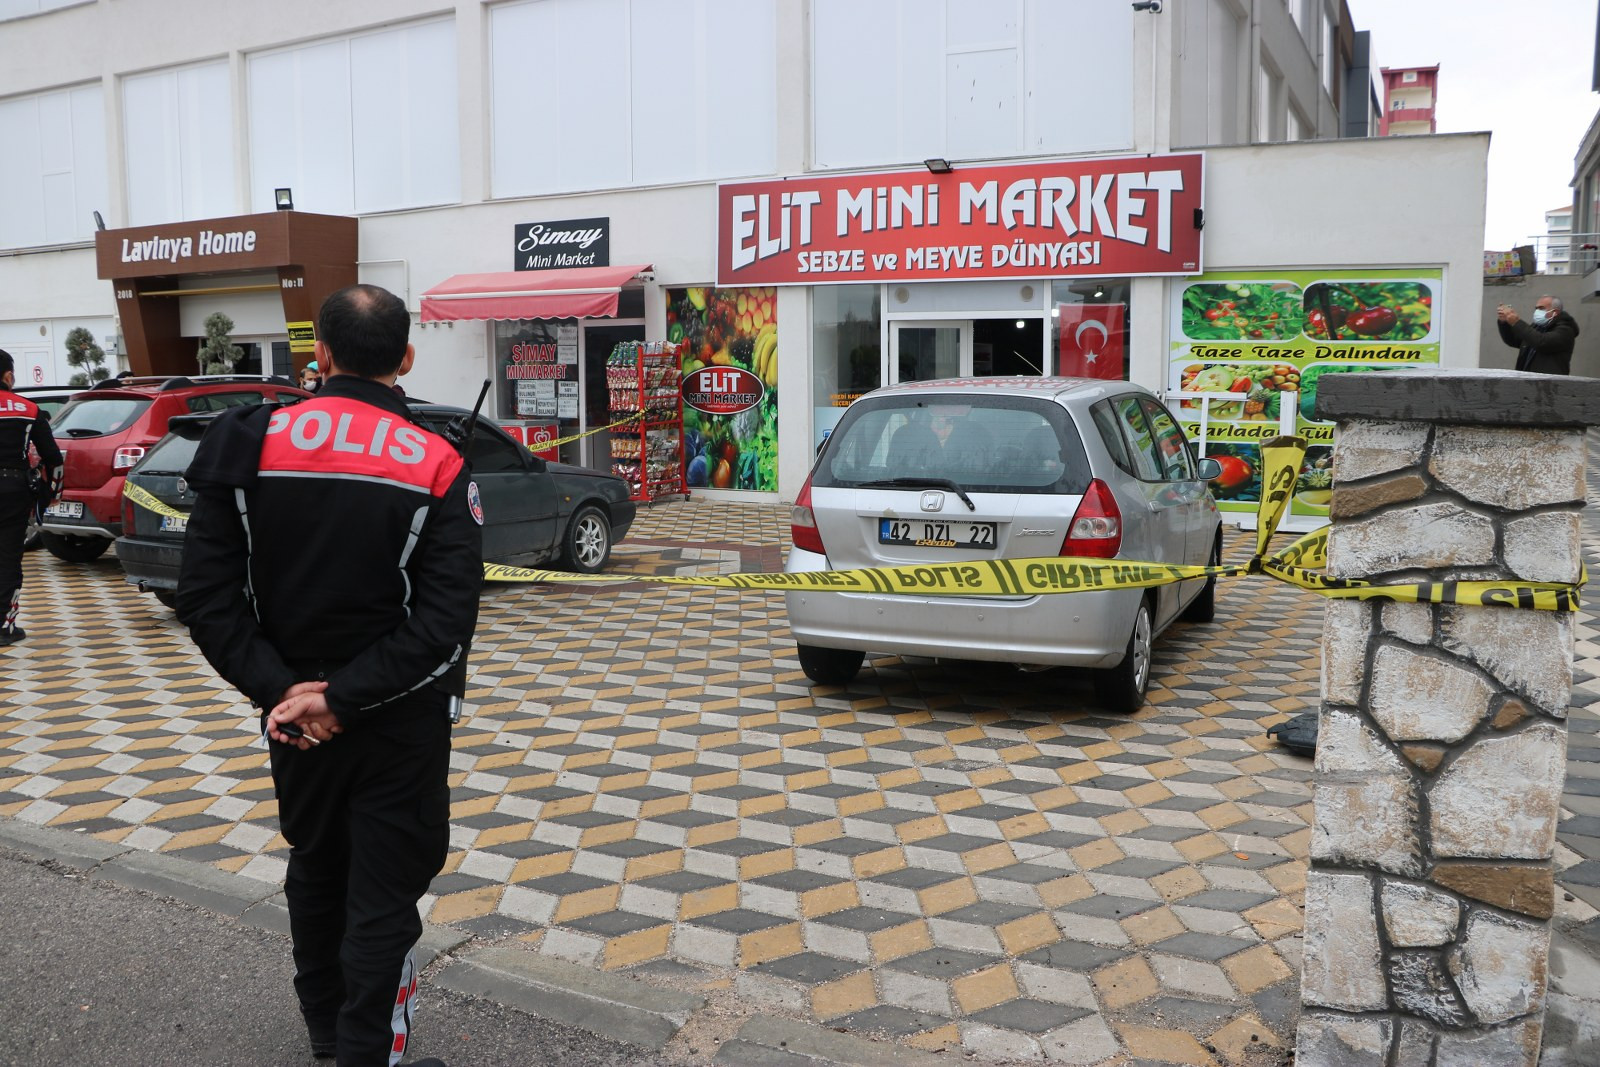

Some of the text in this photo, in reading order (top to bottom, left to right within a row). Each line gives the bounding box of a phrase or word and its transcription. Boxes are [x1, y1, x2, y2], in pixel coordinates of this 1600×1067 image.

[959, 169, 1184, 254] MARKET
[121, 230, 257, 263] Lavinya Home
[517, 224, 603, 252] Simay
[526, 252, 596, 269] Mini Market
[797, 238, 1100, 273] SEBZE ve MEYVE DÜNYASI
[117, 289, 133, 299] 2018
[512, 340, 557, 363] SİMAY
[1190, 345, 1421, 360] Taze Taze Dalından
[713, 393, 757, 405] MARKET
[890, 522, 911, 541] 42
[969, 525, 991, 544] 22
